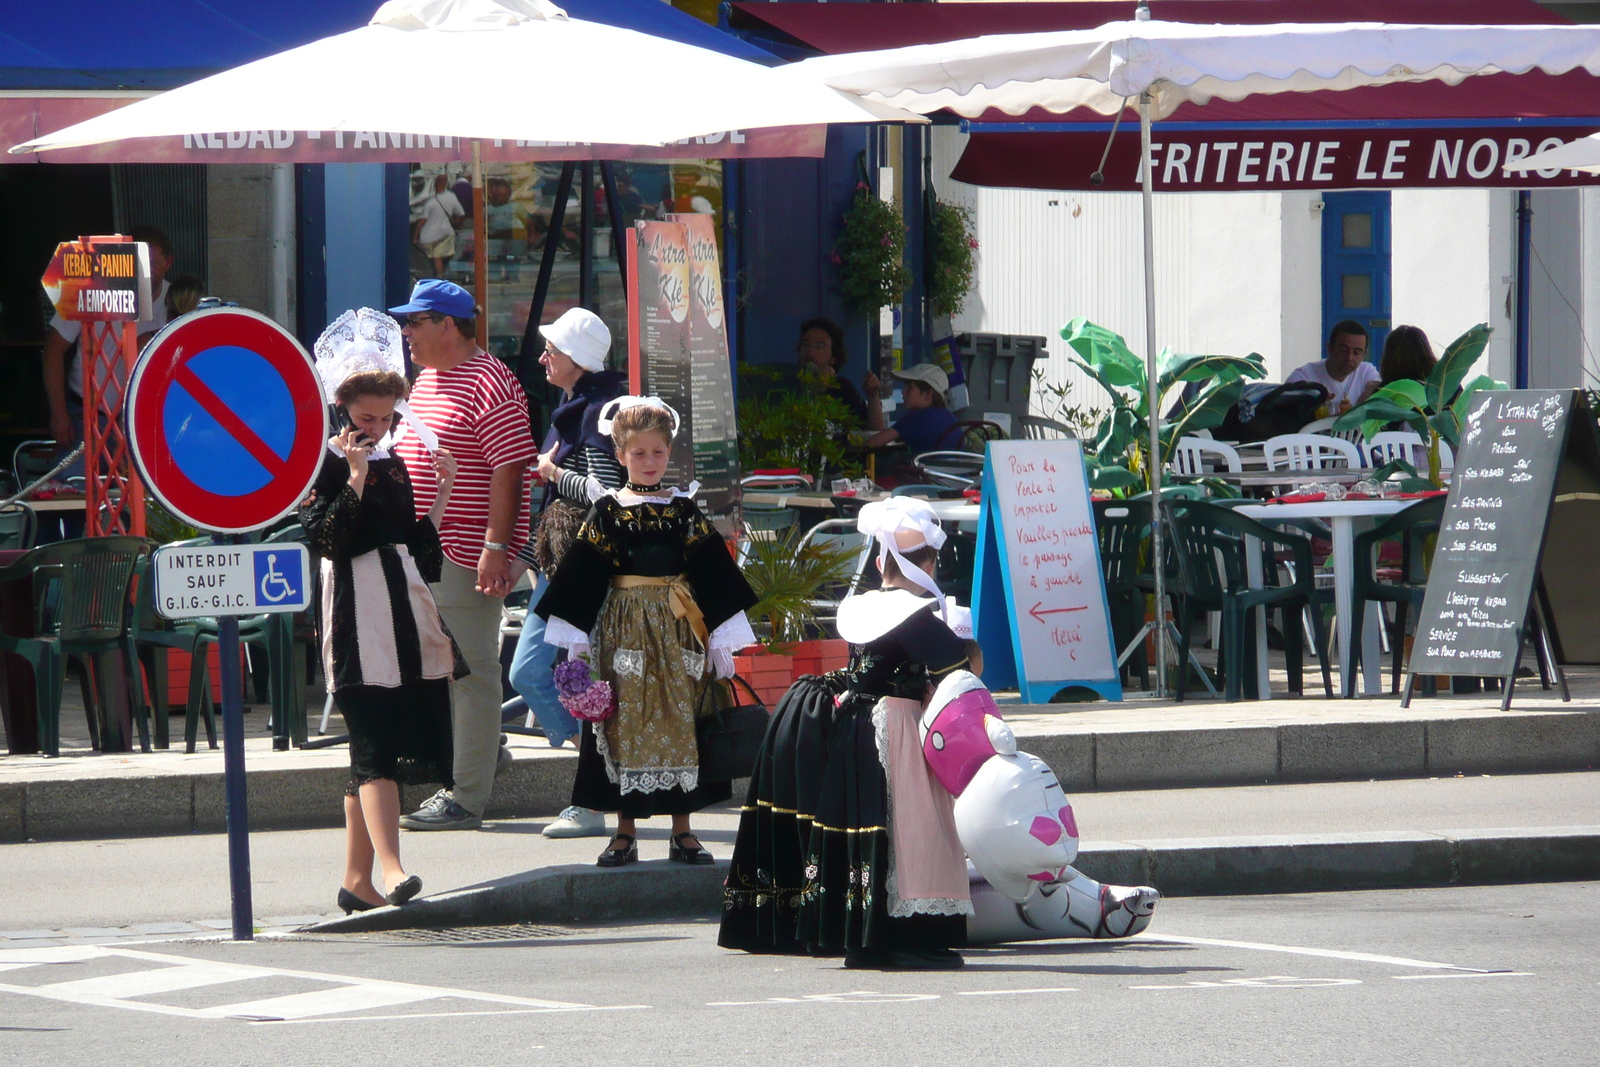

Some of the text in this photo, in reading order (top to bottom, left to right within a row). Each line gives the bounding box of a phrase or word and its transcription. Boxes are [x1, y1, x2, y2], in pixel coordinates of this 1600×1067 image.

[1135, 141, 1340, 183] FRITERIE
[1356, 140, 1410, 180] LE
[64, 254, 93, 276] KEBAB
[101, 254, 135, 277] PANINI
[78, 289, 136, 313] A EMPORTER
[169, 553, 241, 569] INTERDIT
[187, 574, 226, 589] SAUF
[166, 594, 249, 610] G.I.G.-G.I.C.
